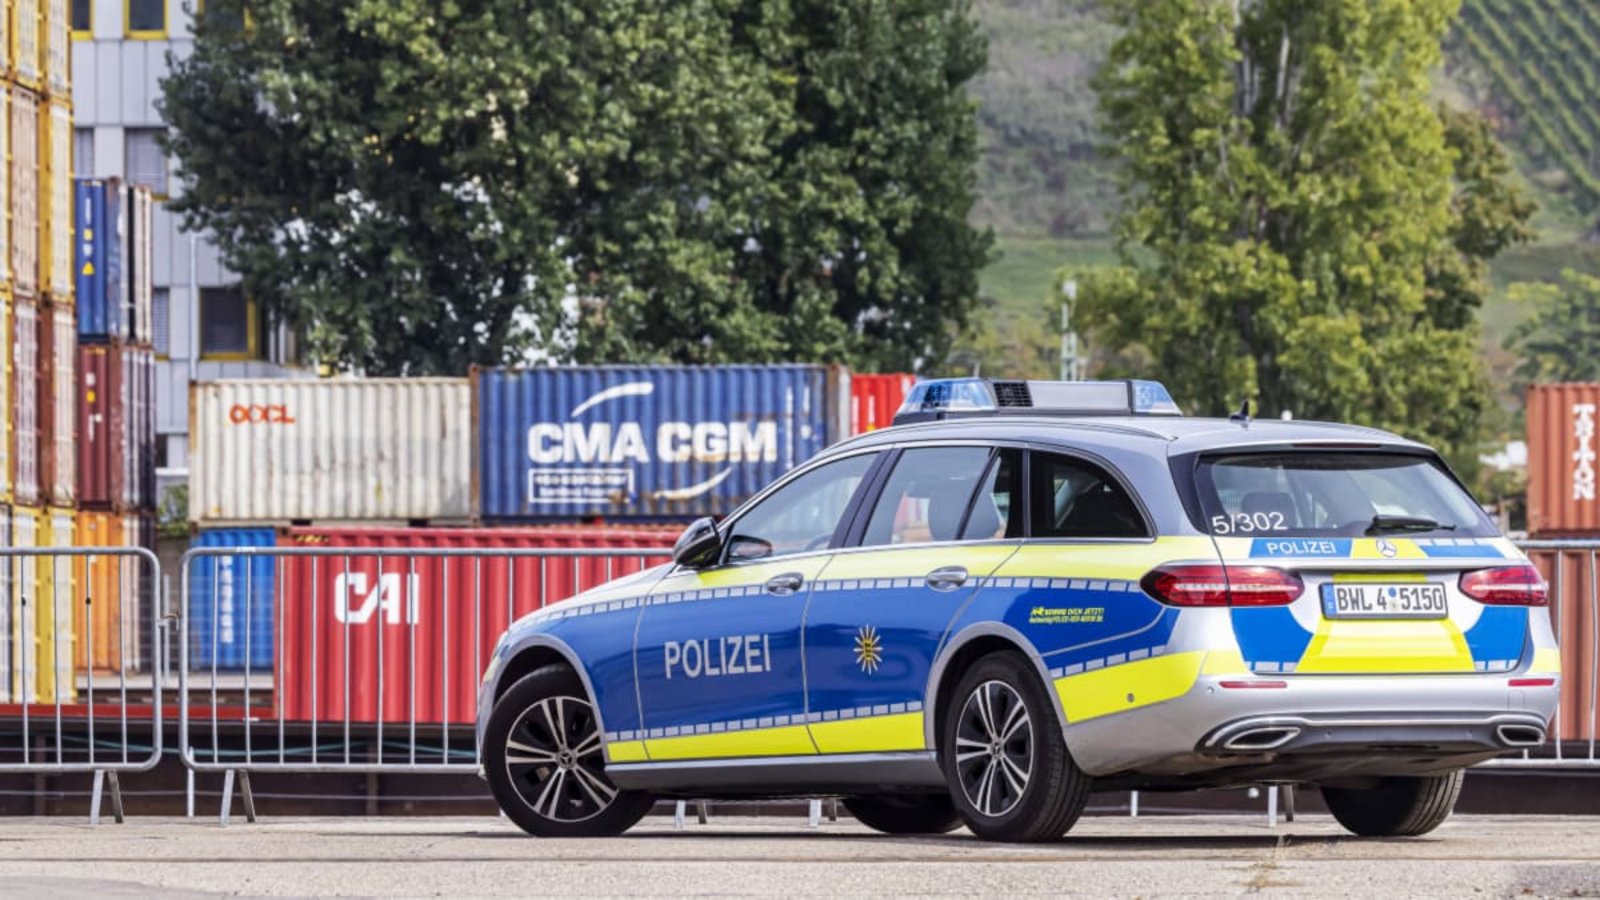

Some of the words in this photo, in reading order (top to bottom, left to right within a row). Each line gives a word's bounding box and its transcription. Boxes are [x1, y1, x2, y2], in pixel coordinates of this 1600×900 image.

[229, 404, 296, 424] OOCL
[527, 421, 649, 463] CMA
[657, 421, 777, 463] CGM
[1212, 511, 1288, 534] 5/302
[1266, 541, 1337, 554] POLIZEI
[334, 571, 420, 625] CAI
[1336, 587, 1373, 611] BWL
[1399, 587, 1444, 611] 5150
[664, 633, 771, 680] POLIZEI
